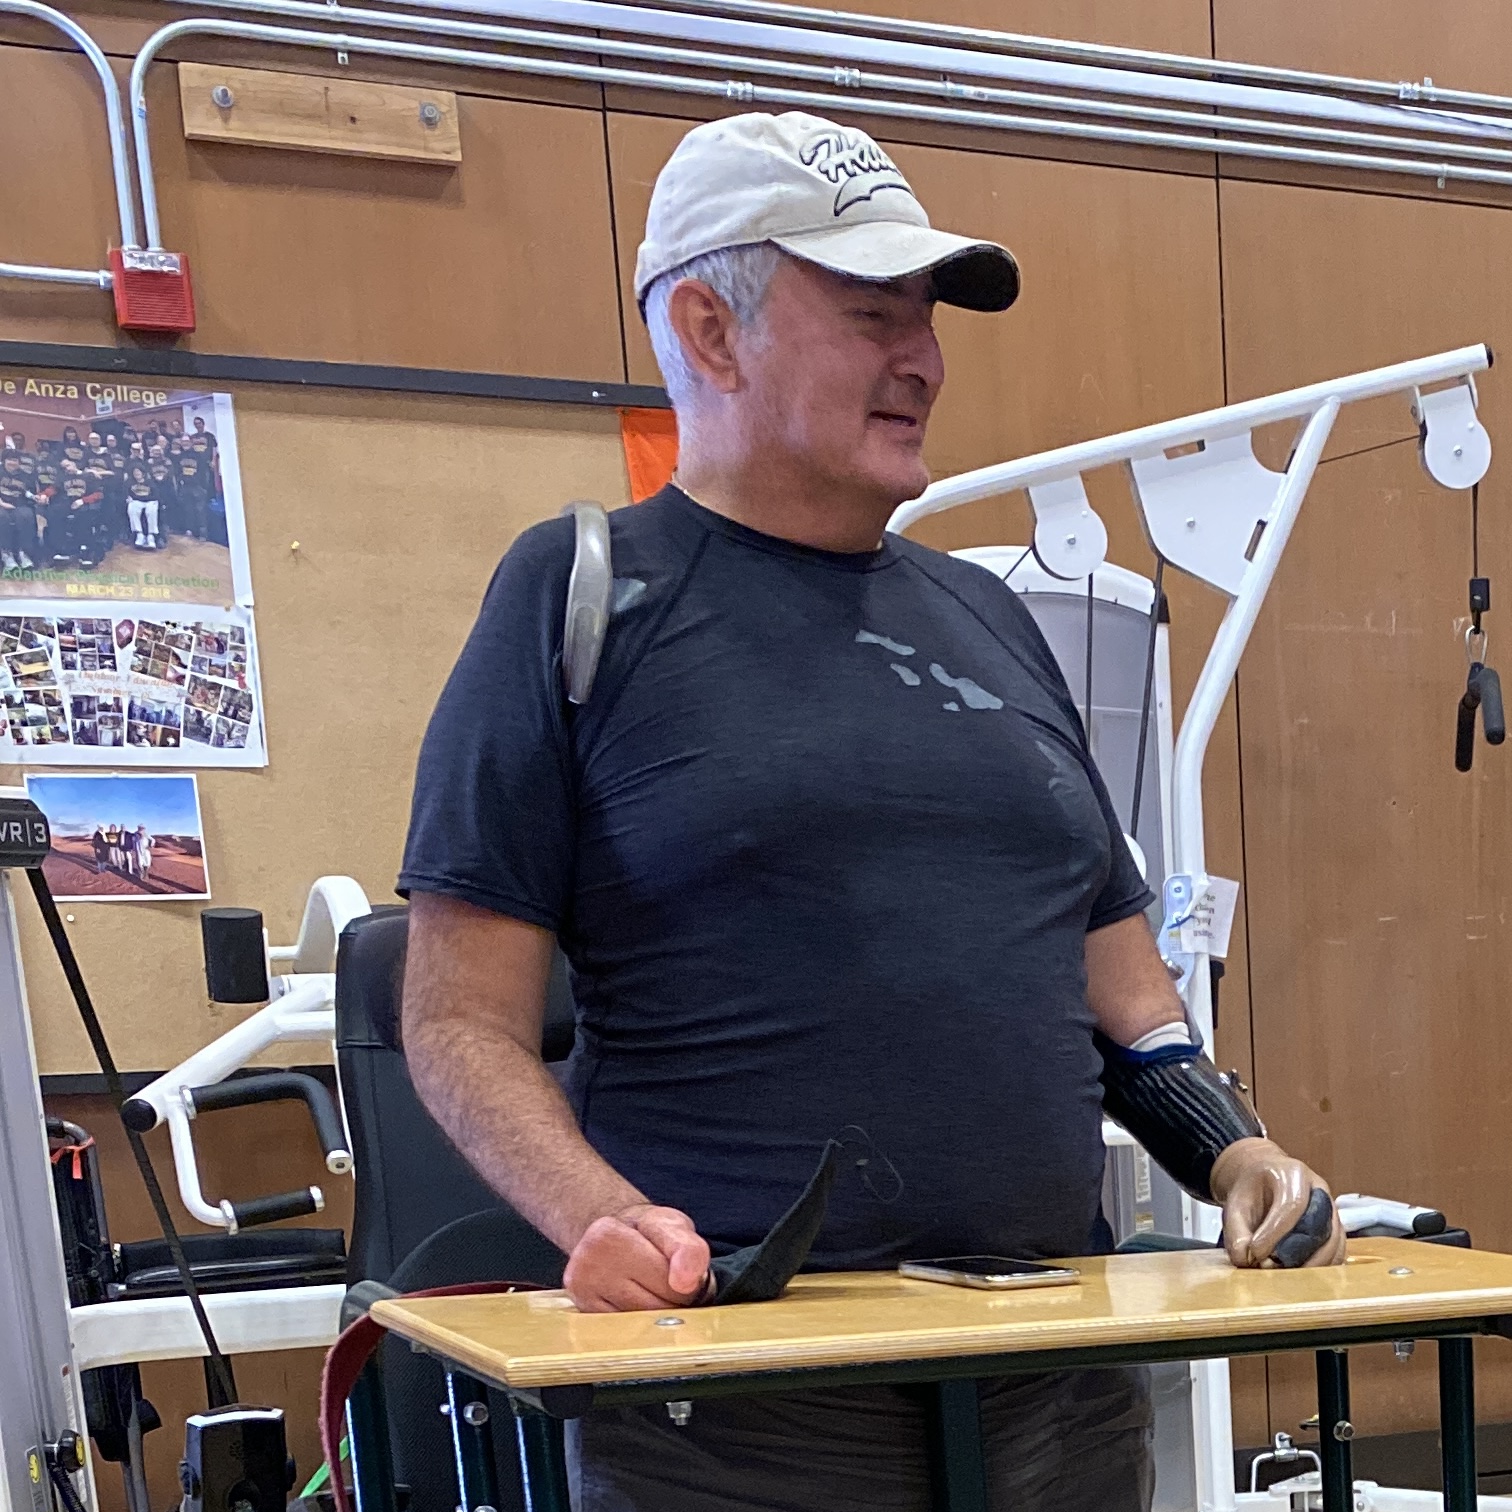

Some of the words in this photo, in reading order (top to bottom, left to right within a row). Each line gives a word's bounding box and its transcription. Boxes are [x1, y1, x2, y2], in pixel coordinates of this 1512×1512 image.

[0, 379, 16, 395] e
[24, 379, 79, 399] Anza
[86, 382, 168, 408] College
[143, 572, 220, 589] Education
[66, 583, 116, 598] MARCH
[141, 586, 172, 599] 2018
